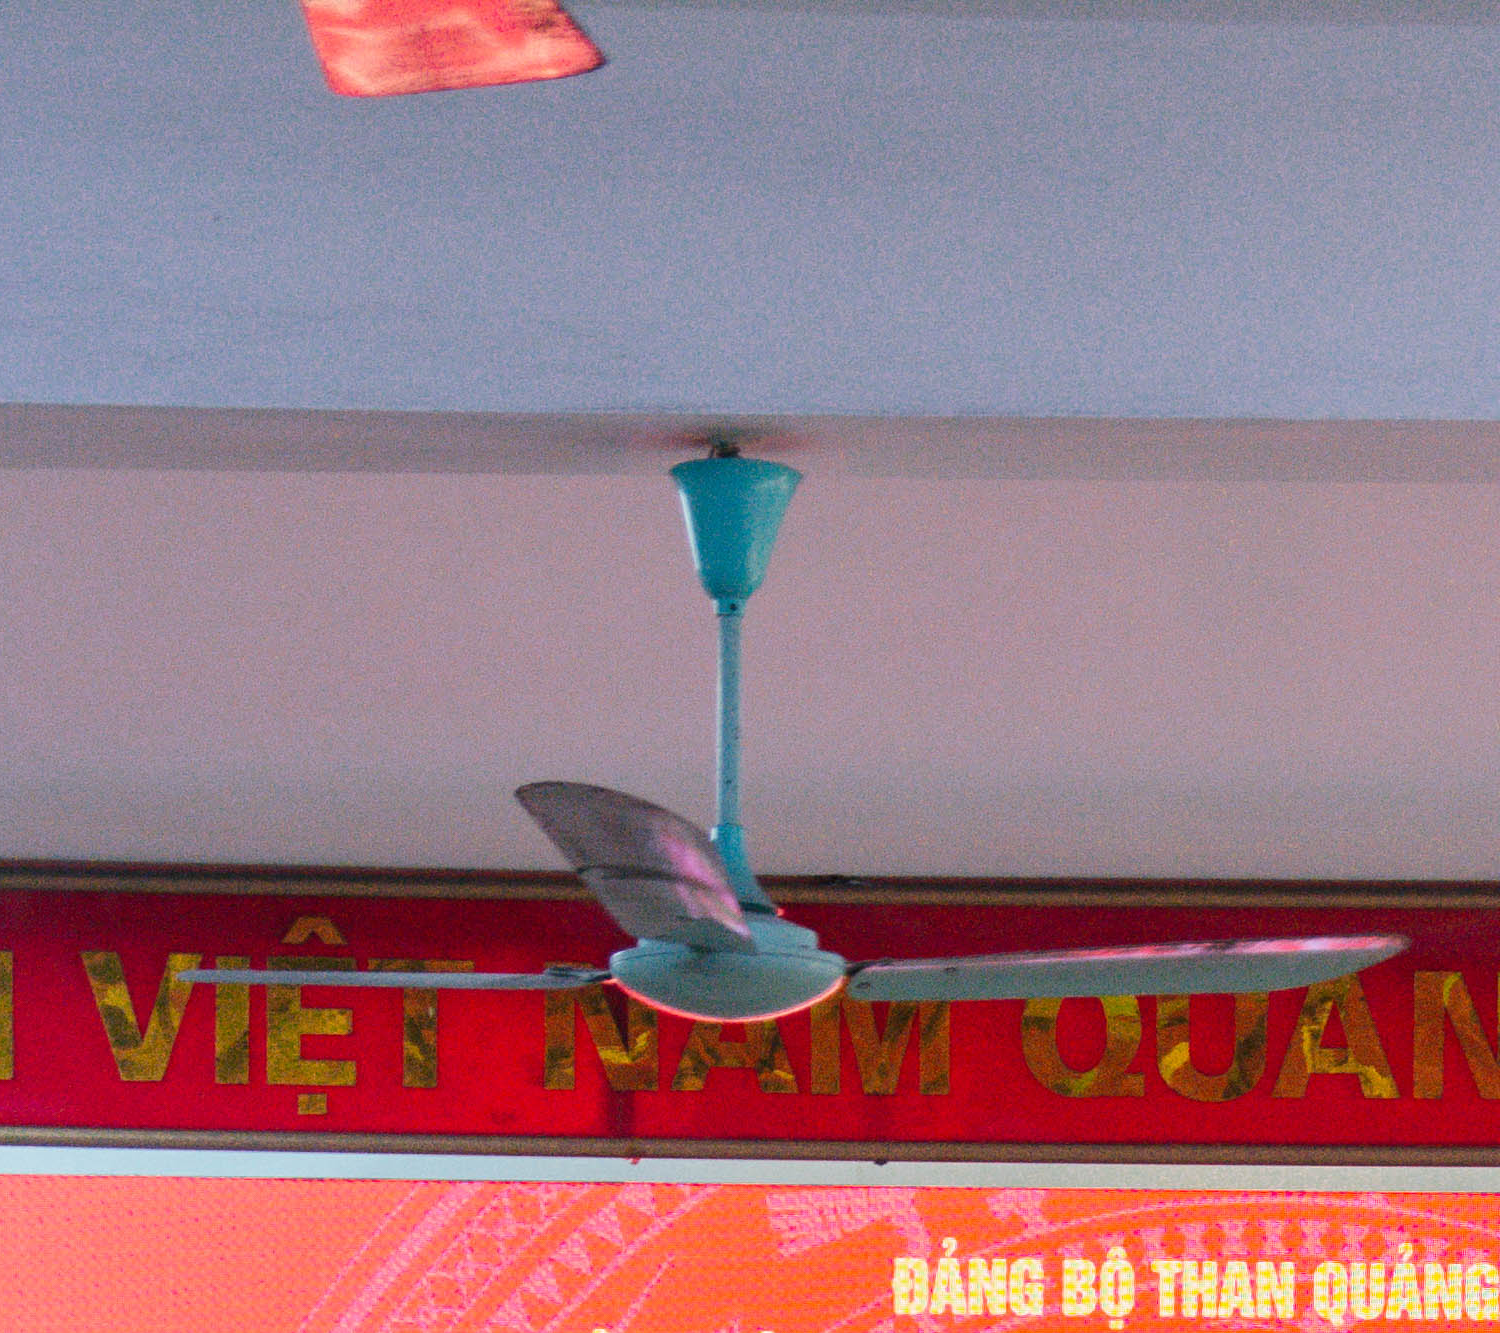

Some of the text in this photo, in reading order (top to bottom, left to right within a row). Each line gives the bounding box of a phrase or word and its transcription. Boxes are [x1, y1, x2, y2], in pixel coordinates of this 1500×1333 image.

[79, 916, 474, 1116] VIỆT
[893, 1238, 1043, 1315] ĐẢNG
[1063, 1247, 1134, 1328] BỘ
[1153, 1260, 1294, 1317] THAN
[1314, 1244, 1498, 1325] QUẢNG
